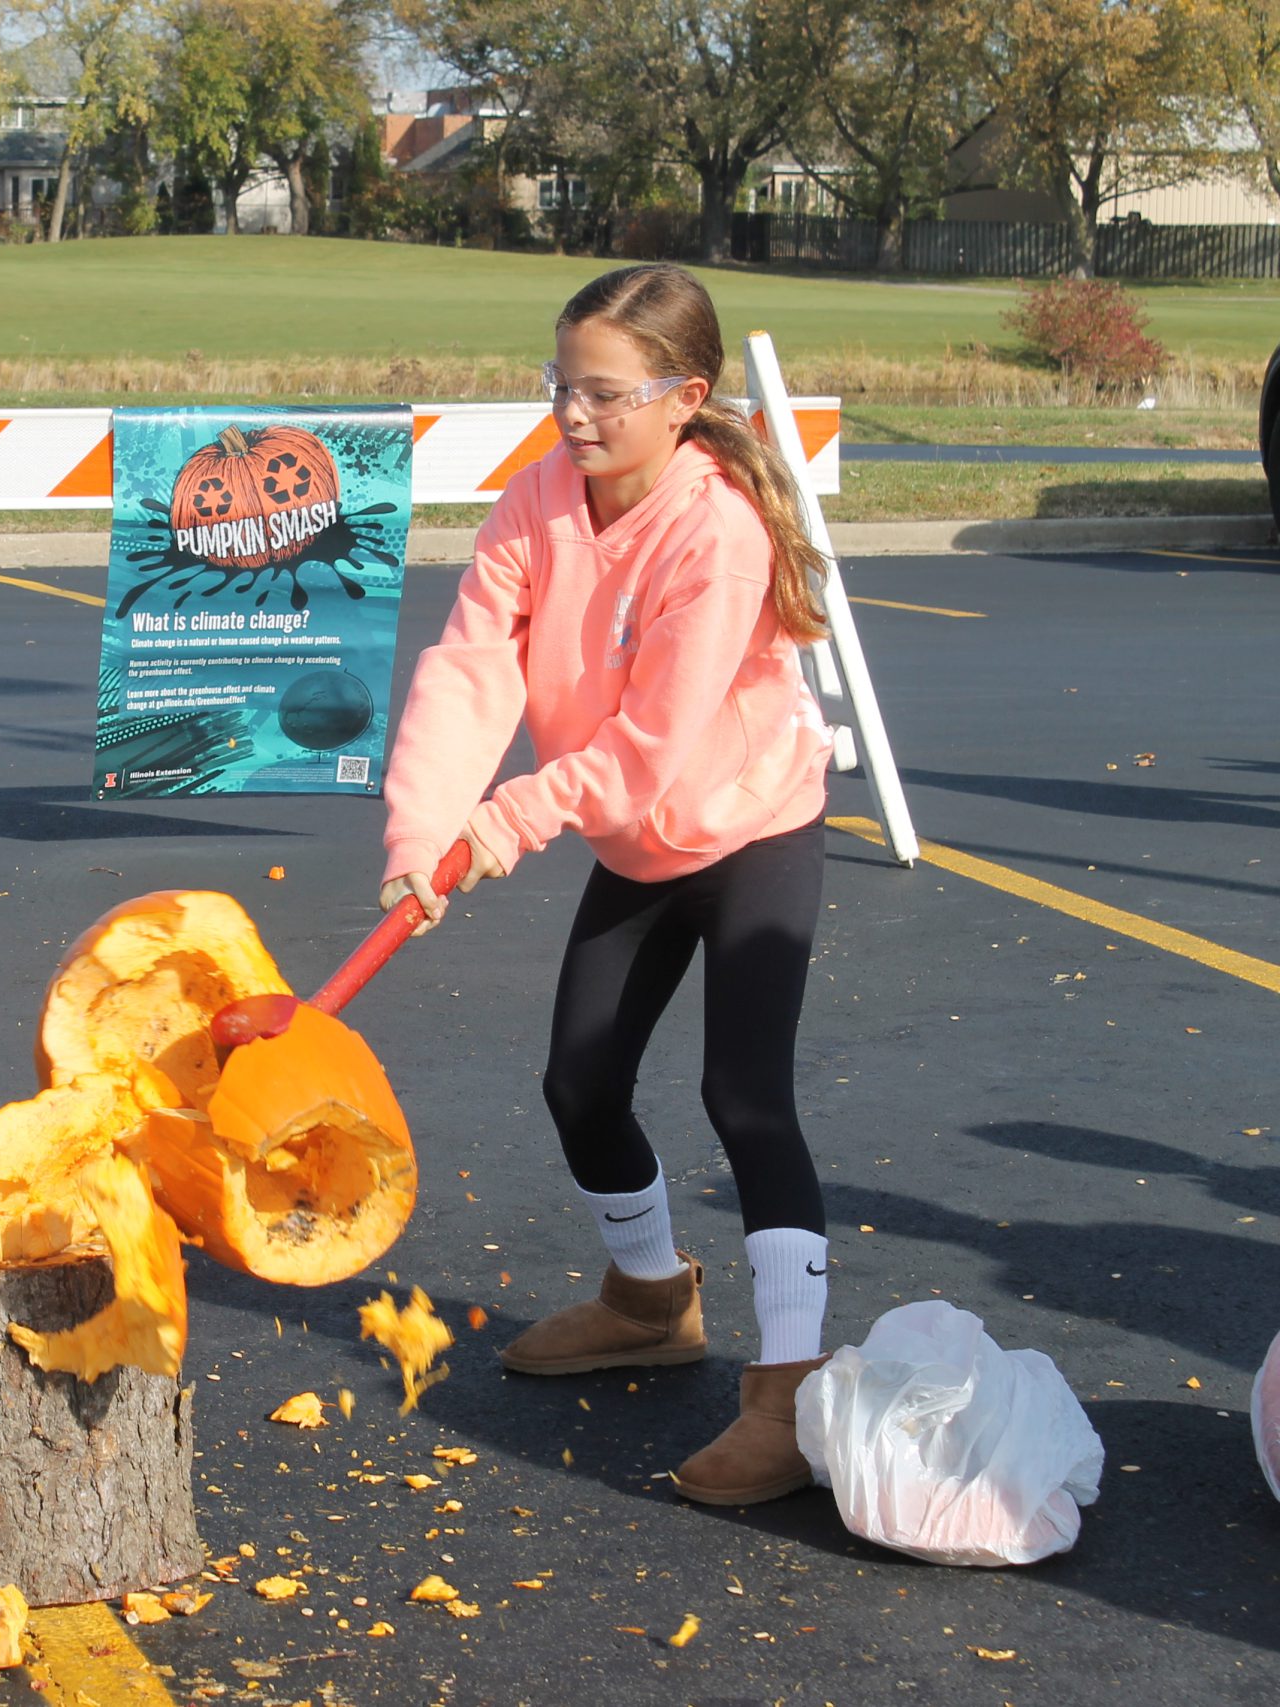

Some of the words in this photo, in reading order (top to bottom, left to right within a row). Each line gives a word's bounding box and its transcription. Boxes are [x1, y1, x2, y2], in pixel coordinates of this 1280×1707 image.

[176, 515, 266, 558] PUMPKIN
[269, 500, 338, 551] SMASH
[132, 612, 169, 632] What
[173, 612, 186, 631] is
[191, 611, 245, 631] climate
[249, 610, 310, 633] change?
[131, 638, 153, 648] Climate
[154, 638, 175, 649] change
[176, 637, 183, 647] is
[189, 637, 210, 646] natural
[211, 638, 217, 646] or
[218, 637, 238, 646] human
[239, 636, 260, 645] caused
[261, 636, 281, 646] change
[283, 635, 289, 645] in
[290, 636, 314, 645] weather
[314, 635, 341, 646] patterns.
[149, 658, 172, 667] activity
[180, 658, 206, 666] currently
[207, 657, 242, 666] contributing
[274, 656, 295, 665] change
[296, 656, 304, 664] by
[304, 656, 341, 666] accelerating
[128, 668, 138, 677] the
[138, 668, 172, 678] greenhouse
[173, 667, 193, 675] effect.
[127, 690, 143, 698] Learn
[144, 689, 159, 697] more
[160, 687, 177, 696] about
[177, 687, 187, 696] the
[188, 686, 222, 697] greenhouse
[222, 685, 240, 693] effect
[241, 685, 253, 693] and
[253, 684, 275, 693] climate
[127, 701, 147, 711] change
[148, 700, 155, 709] at
[130, 770, 154, 779] Illinois
[155, 767, 192, 777] Extension
